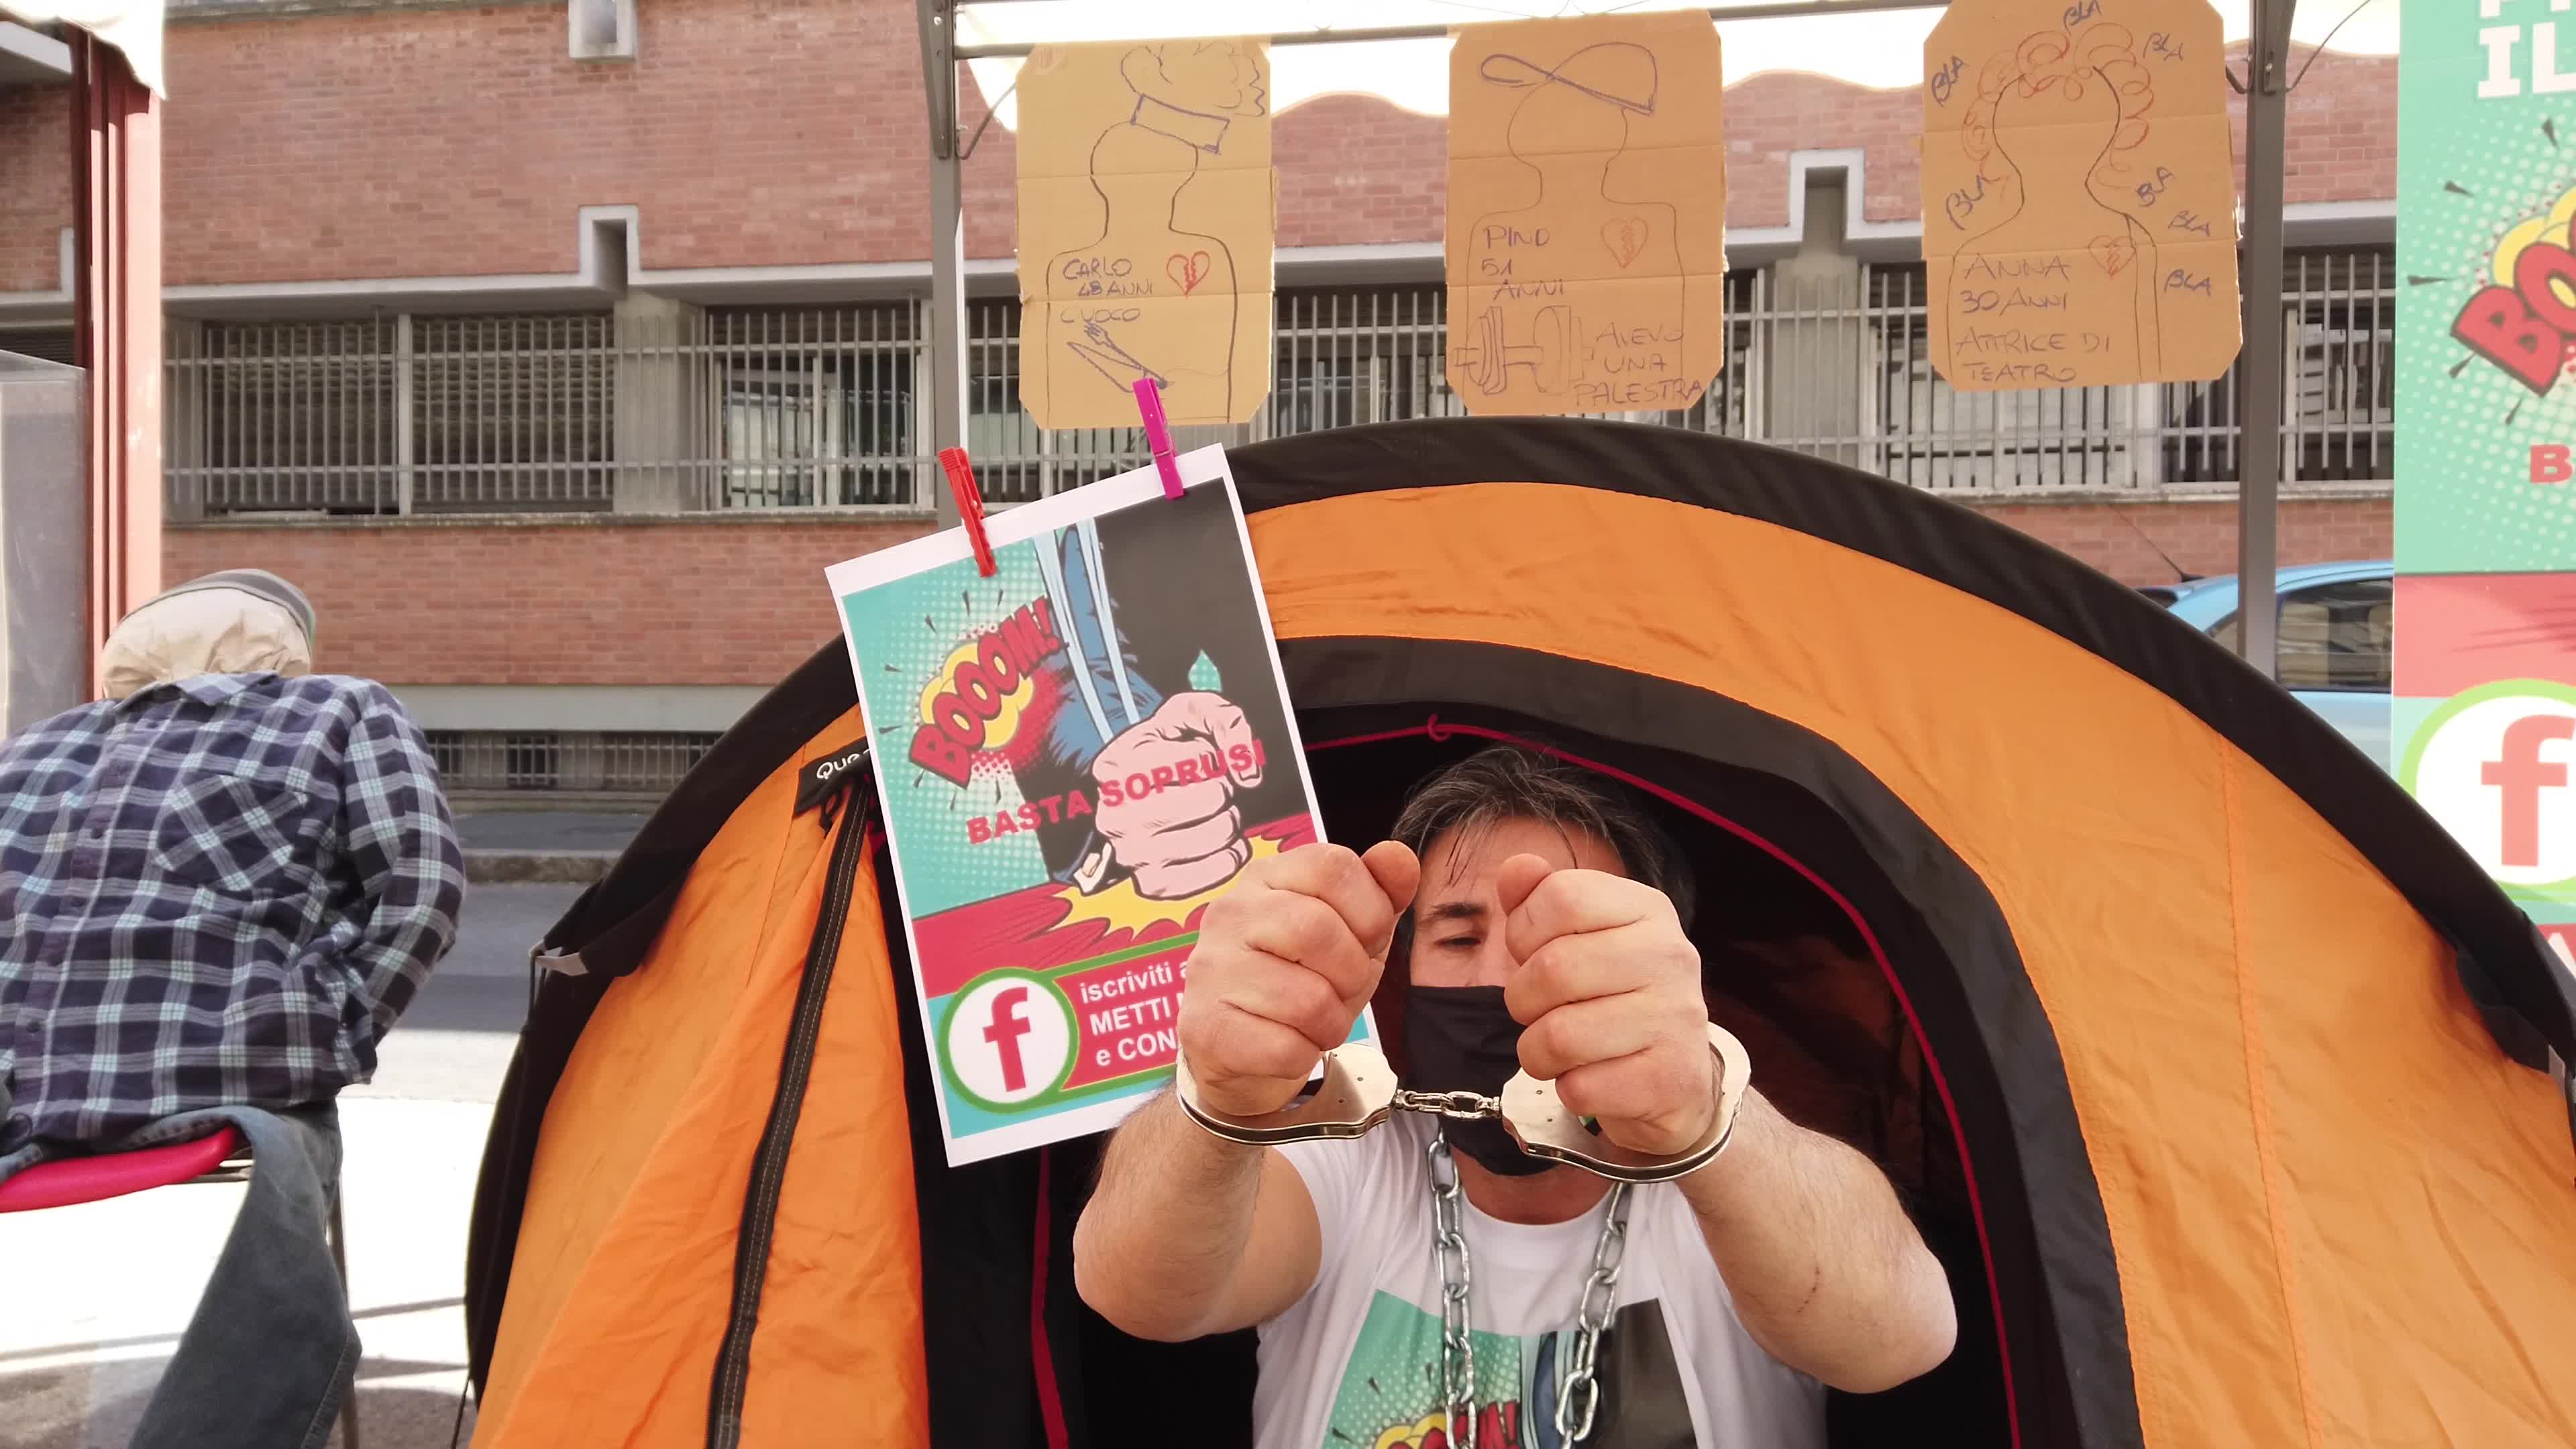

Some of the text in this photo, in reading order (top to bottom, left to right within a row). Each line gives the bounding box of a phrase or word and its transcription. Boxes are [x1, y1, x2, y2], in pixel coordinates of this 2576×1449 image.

[1483, 225, 1550, 249] PINO
[1063, 256, 1132, 279] CARLO
[1481, 258, 1512, 276] 51
[1964, 253, 2071, 282] ANNA
[1106, 279, 1153, 296] ANNI
[1493, 278, 1564, 301] ANNI
[1960, 287, 2067, 317] 30 ANNI
[1061, 308, 1140, 323] CUOCO
[1955, 327, 2110, 354] ATTRICE DI
[1604, 353, 1668, 374] UNA
[1963, 362, 2077, 383] TEATRO
[1572, 378, 1703, 407] PALESTRA
[910, 596, 1061, 788] BOOOM!
[816, 748, 870, 780] Que
[967, 739, 1267, 845] BASTA SOPRUSI
[1079, 961, 1173, 1004] iscriviti
[1089, 996, 1171, 1036] METTI
[1095, 1049, 1111, 1067] e
